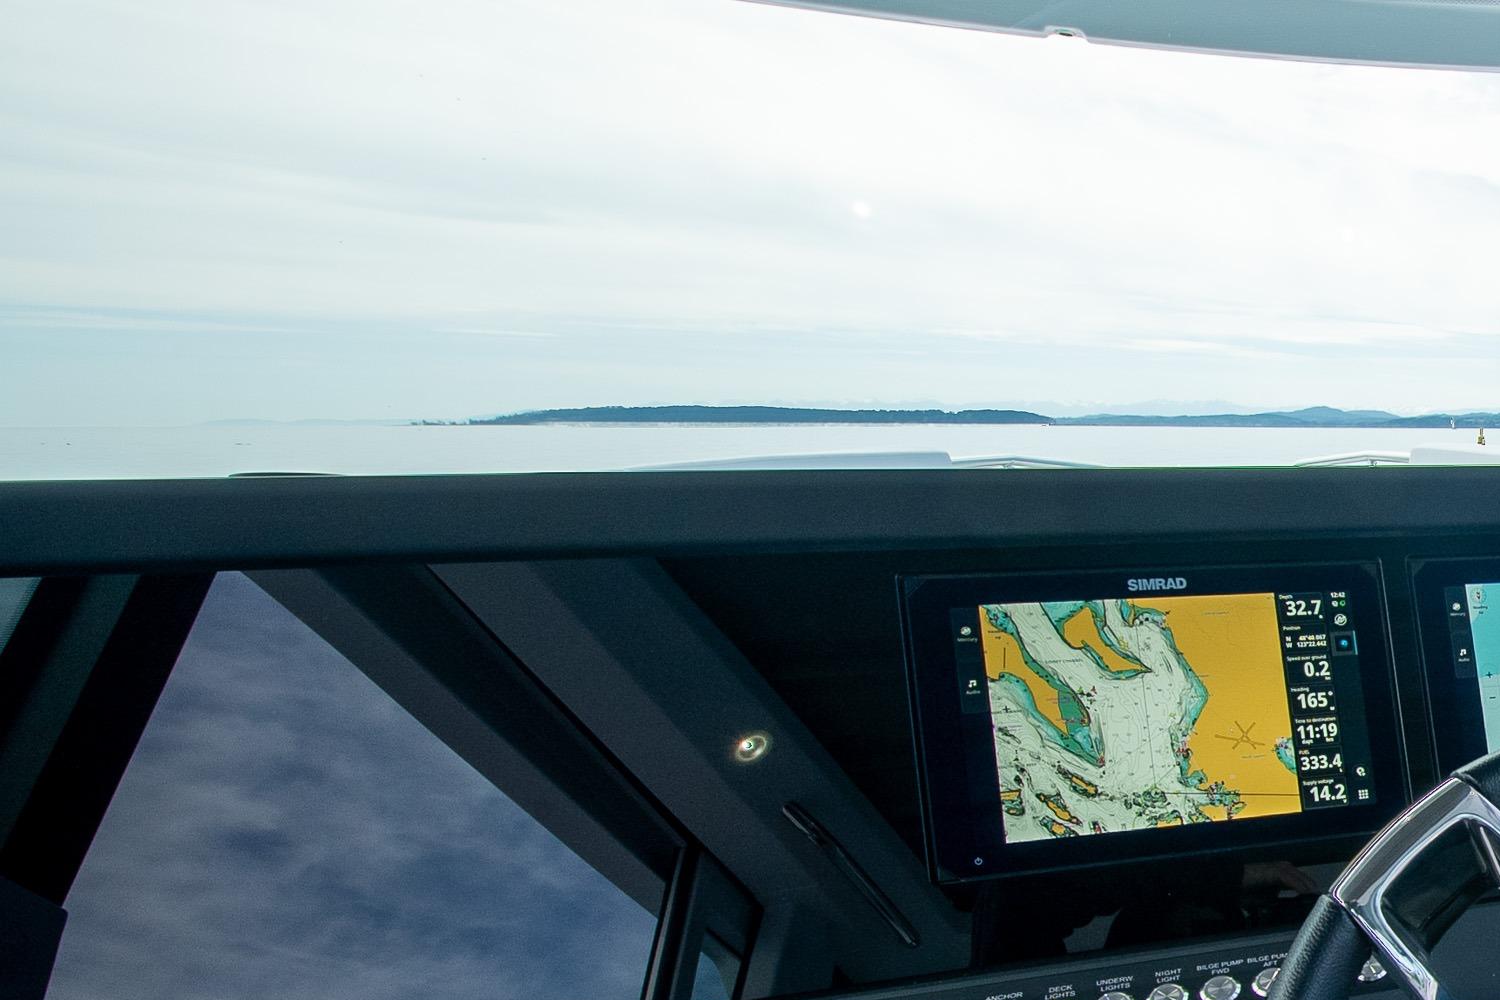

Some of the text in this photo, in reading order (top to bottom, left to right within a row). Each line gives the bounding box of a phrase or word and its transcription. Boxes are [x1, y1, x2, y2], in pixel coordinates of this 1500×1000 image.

[1127, 576, 1187, 592] SIMRAD
[1285, 600, 1322, 616] 32.7
[1303, 661, 1330, 677] 0.2
[1297, 723, 1338, 739] 11:19
[1300, 753, 1342, 770] 333.4
[1310, 784, 1347, 802] 14.2
[1247, 952, 1290, 964] BILGE PUM
[1263, 960, 1278, 968] AFT
[1196, 959, 1244, 971] BILGE PUMP
[1155, 968, 1182, 978] NIGHT
[1211, 967, 1230, 976] FWD
[1096, 975, 1133, 987] UNDERW
[1156, 974, 1181, 984] LIGHT
[1048, 984, 1073, 994] DECK
[1100, 982, 1131, 992] LIGHTS
[1044, 990, 1076, 1000] LIGHTS
